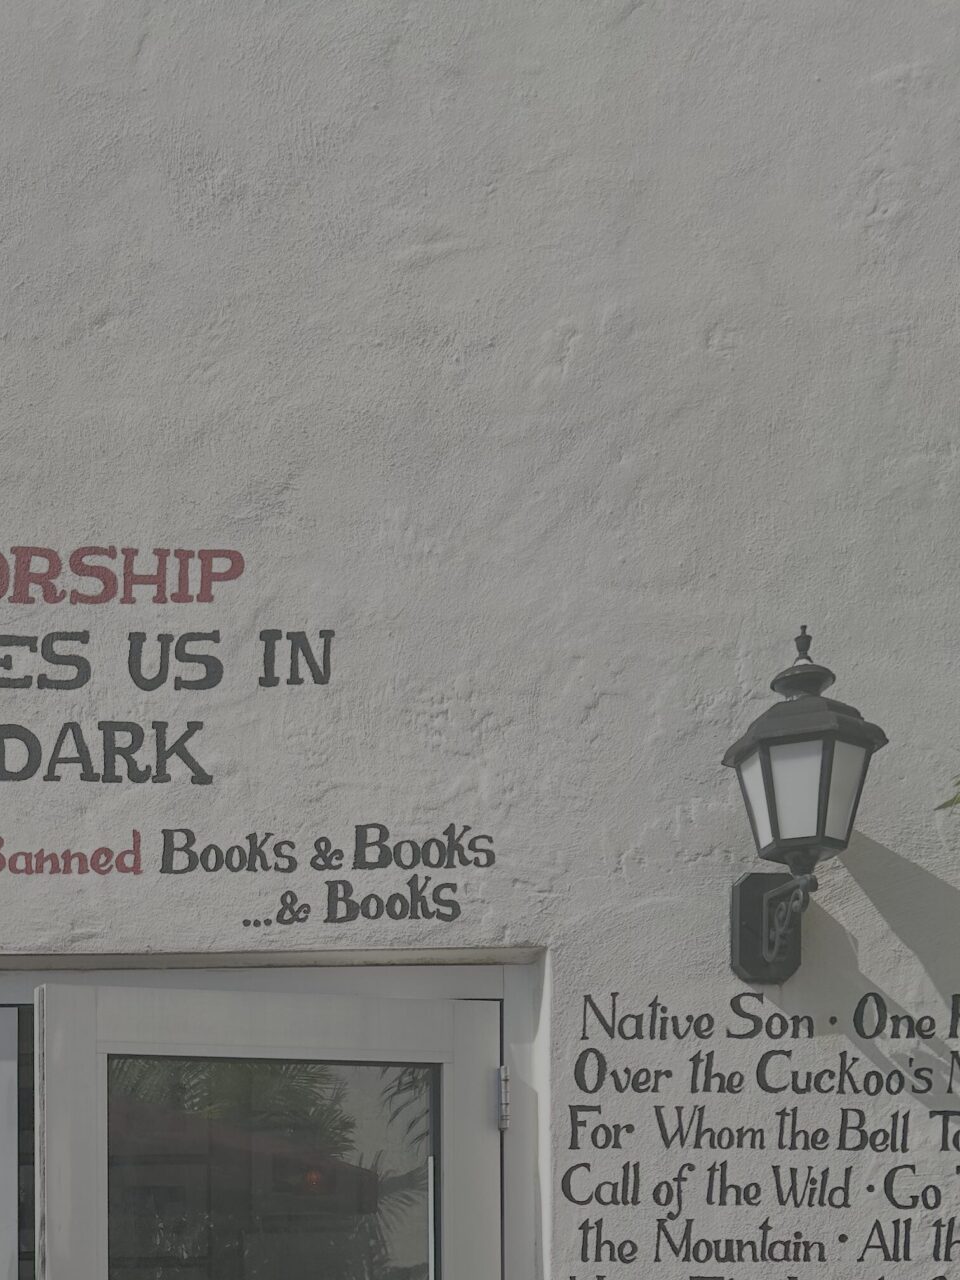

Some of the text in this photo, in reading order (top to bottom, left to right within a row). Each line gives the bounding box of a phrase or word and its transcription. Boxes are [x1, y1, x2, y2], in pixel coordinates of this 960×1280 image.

[128, 630, 224, 692] US
[258, 629, 335, 688] IN
[310, 837, 344, 871] &
[580, 992, 714, 1040] Native
[726, 992, 814, 1040] Son
[853, 992, 935, 1039] One
[574, 1048, 673, 1094] Over
[689, 1050, 744, 1094] the
[568, 1104, 635, 1150] For
[653, 1105, 766, 1150] Whom
[775, 1106, 830, 1151] the
[835, 1107, 910, 1153] Bell
[561, 1160, 941, 1220] Call of the Wild Go
[578, 1218, 638, 1264] the
[653, 1217, 827, 1263] Mountain
[857, 1218, 912, 1263] All
